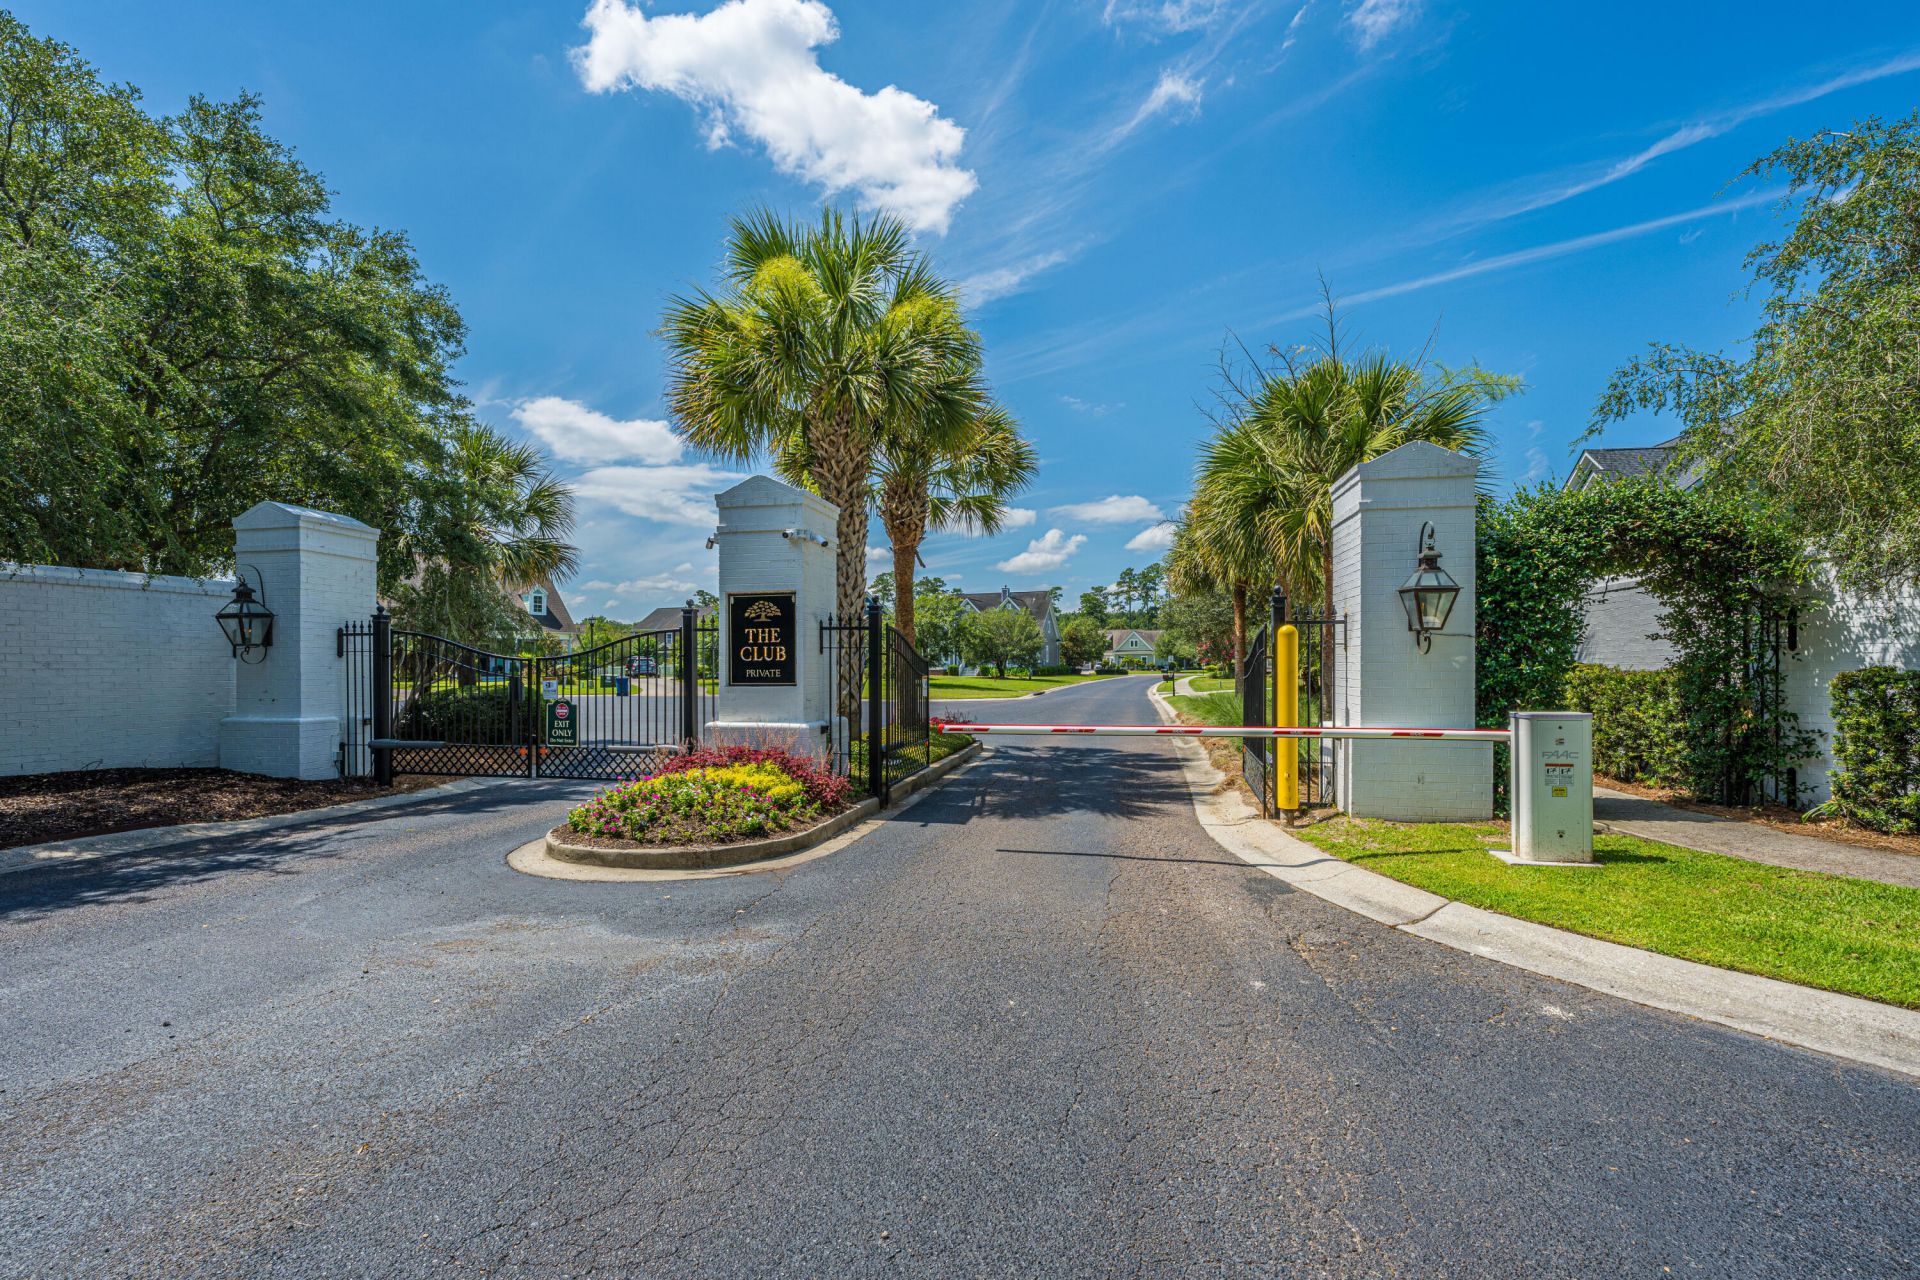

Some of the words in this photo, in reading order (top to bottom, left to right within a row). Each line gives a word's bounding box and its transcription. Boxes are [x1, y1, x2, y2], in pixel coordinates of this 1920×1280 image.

[744, 627, 781, 643] THE
[740, 646, 786, 661] CLUB
[746, 669, 781, 677] PRIVATE
[554, 720, 570, 728] EXIT
[551, 729, 572, 737] ONLY
